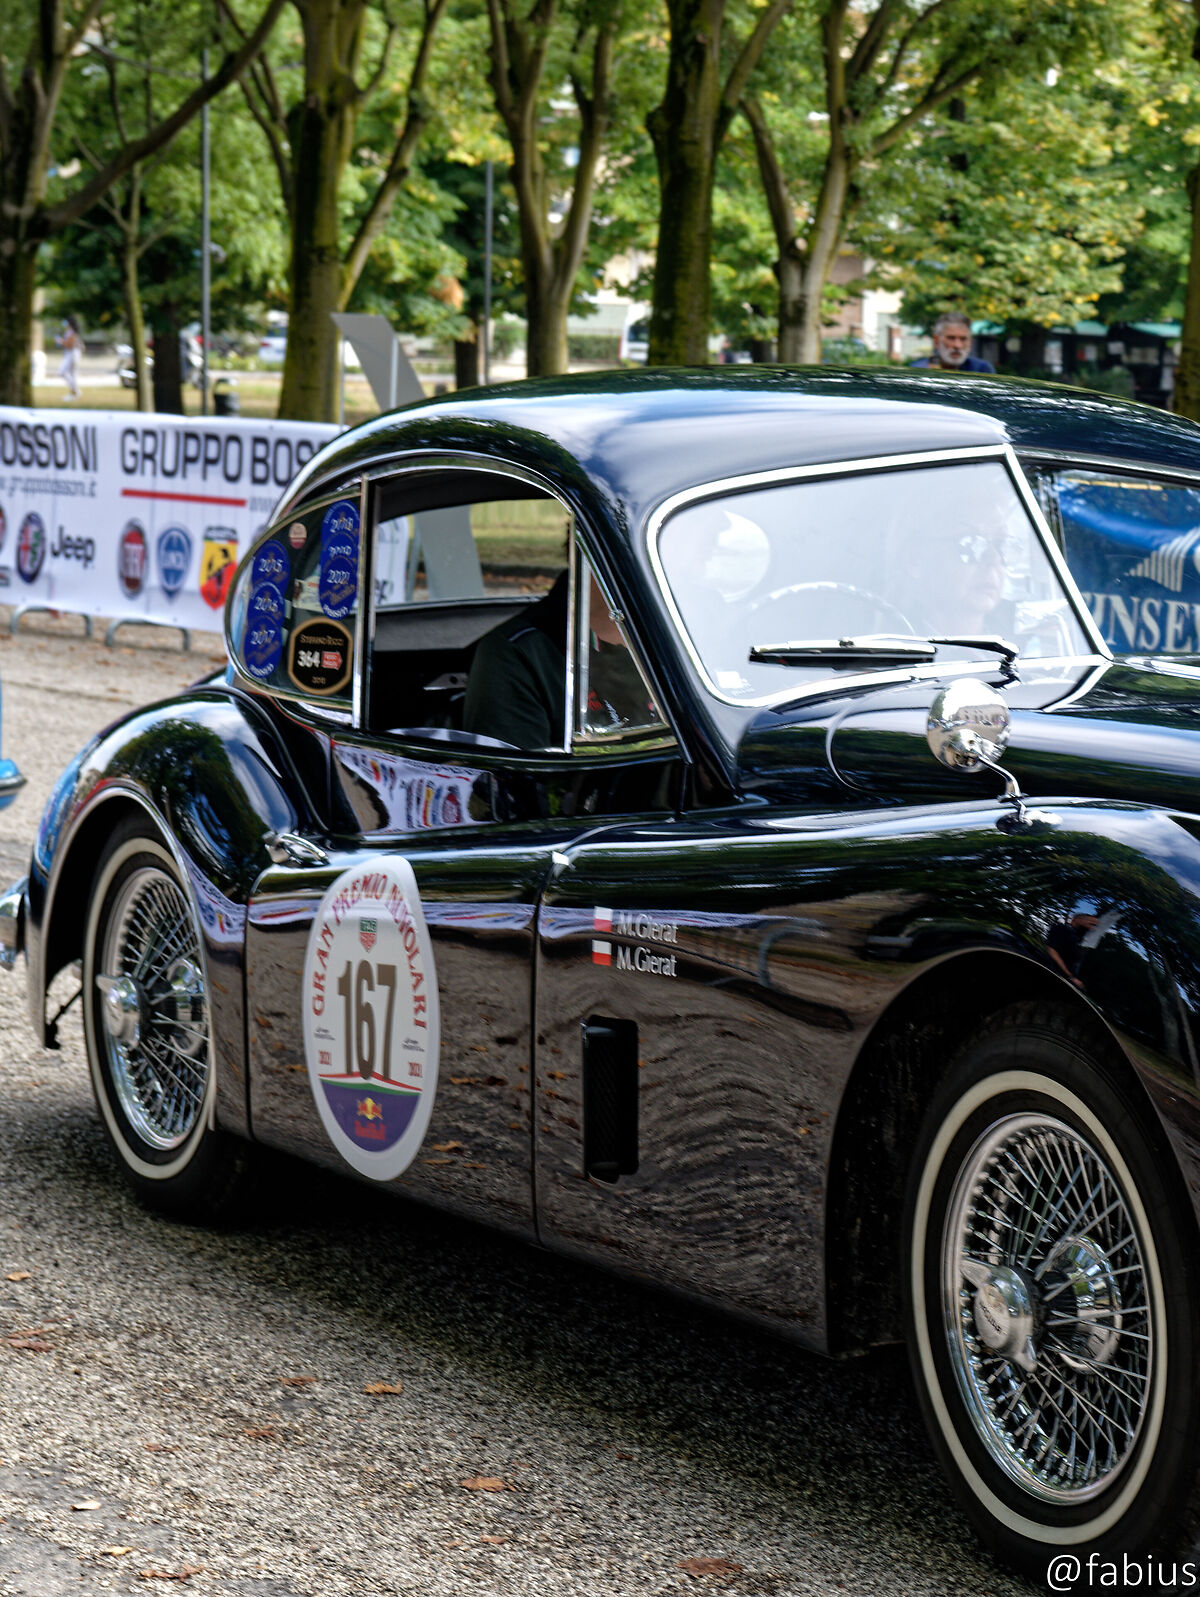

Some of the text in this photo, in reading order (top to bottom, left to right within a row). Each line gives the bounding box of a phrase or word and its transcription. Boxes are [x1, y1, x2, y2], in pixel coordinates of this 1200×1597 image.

[121, 428, 329, 487] GRUPPO BOS
[51, 525, 94, 569] Jeep
[616, 944, 677, 977] M.Gierat
[337, 959, 397, 1080] 167
